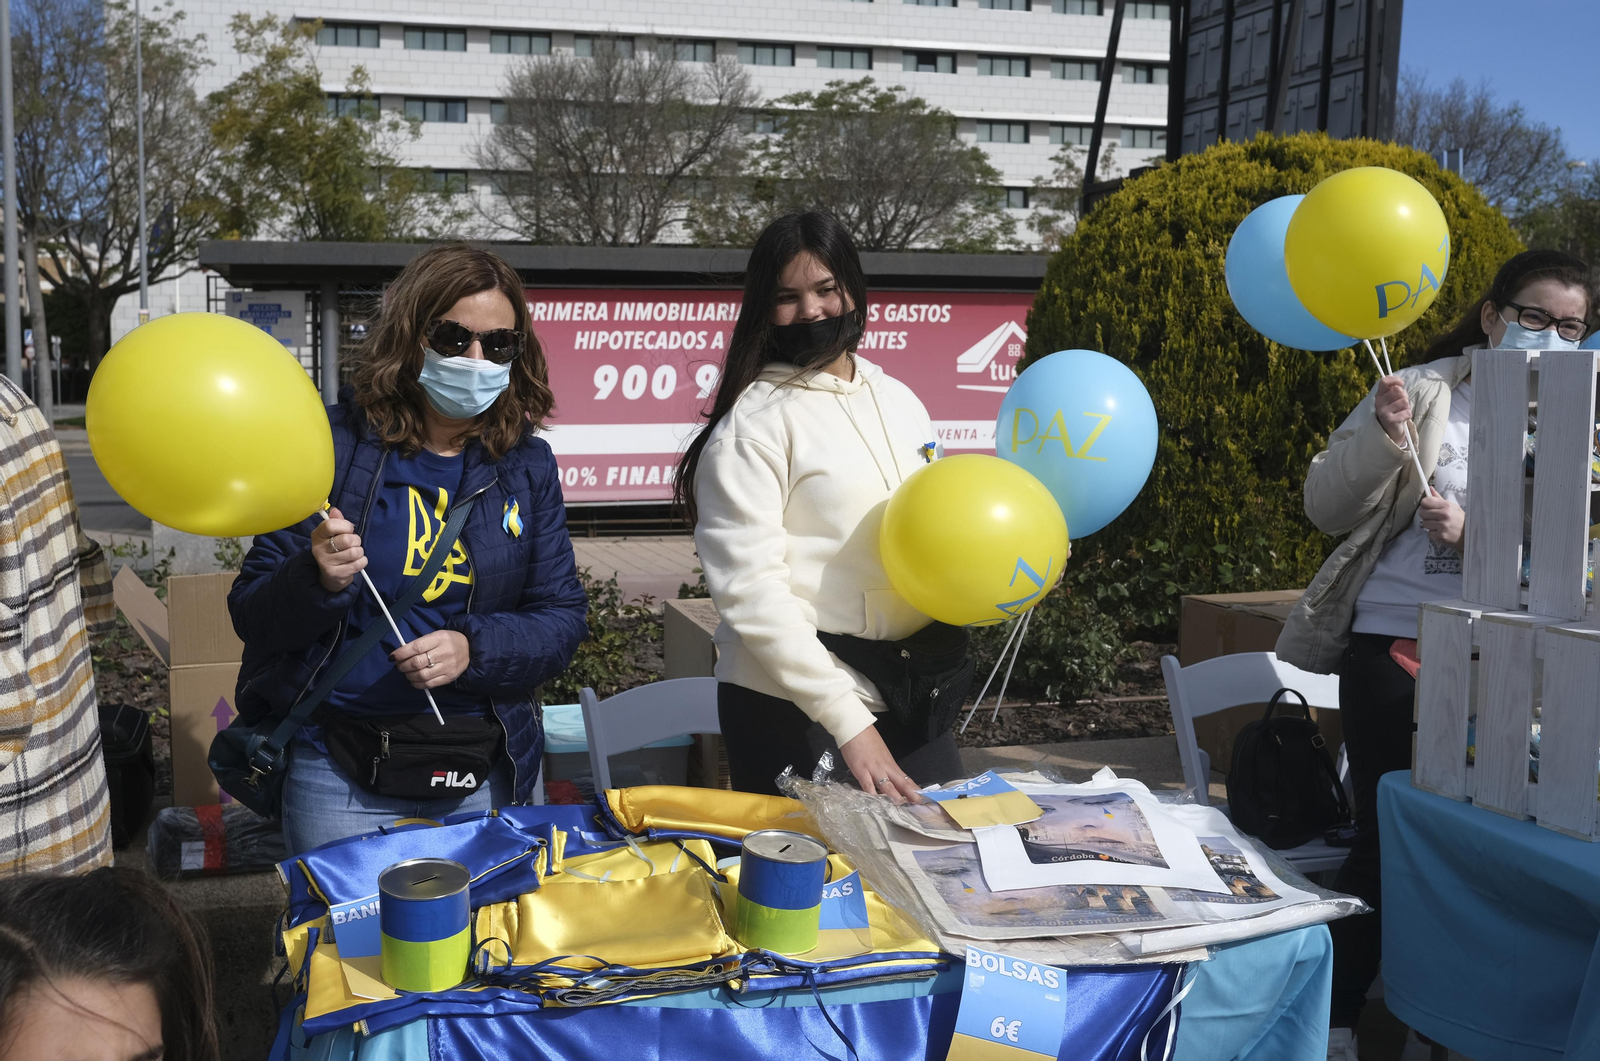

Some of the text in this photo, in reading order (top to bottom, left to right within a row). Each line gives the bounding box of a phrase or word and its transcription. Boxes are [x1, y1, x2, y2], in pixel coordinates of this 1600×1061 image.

[613, 303, 742, 321] INMOBILIARI
[884, 304, 951, 323] GASTOS
[574, 331, 724, 350] HIPOTECADOS A
[593, 364, 677, 400] 900
[937, 428, 977, 440] VENTA
[1011, 408, 1113, 462] PAZ
[430, 770, 477, 788] FILA
[1051, 852, 1095, 862] Córdoba
[1207, 895, 1231, 903] por
[1234, 896, 1247, 904] la
[966, 949, 1059, 989] BOLSAS
[990, 1016, 1022, 1043] 6€
